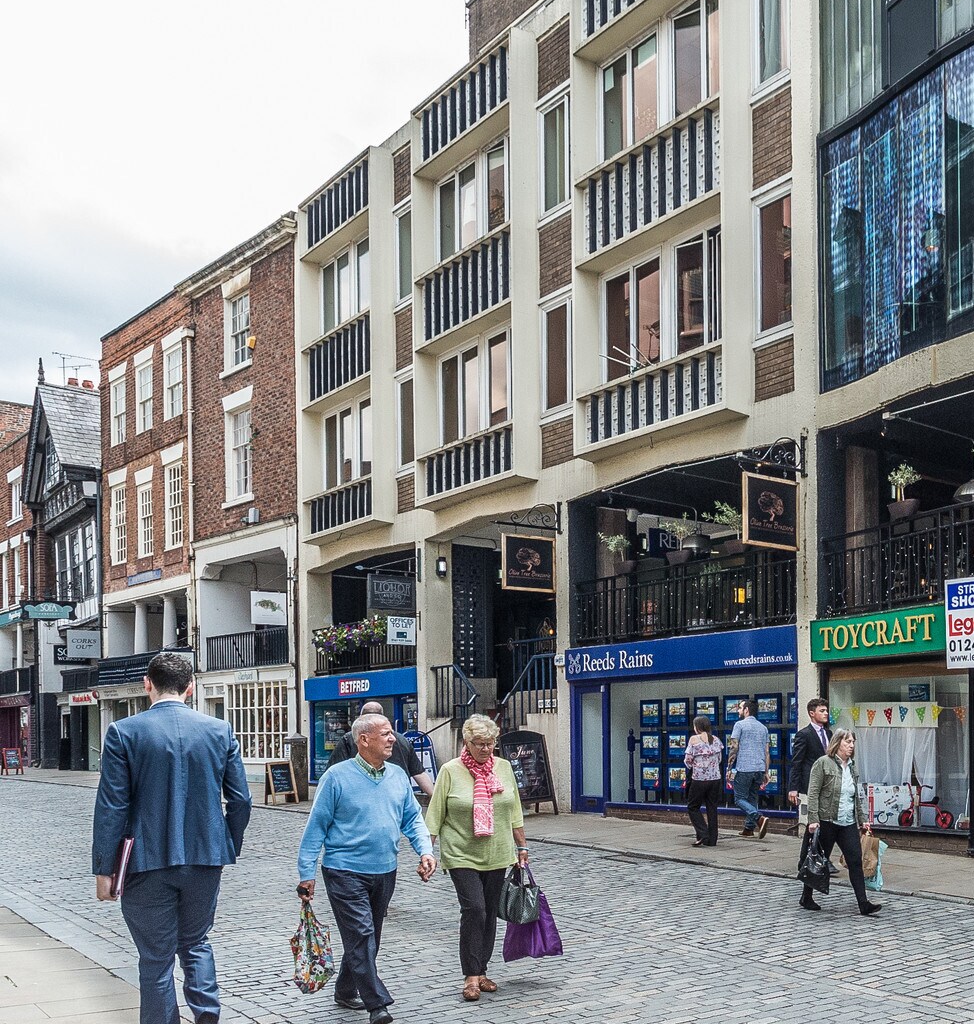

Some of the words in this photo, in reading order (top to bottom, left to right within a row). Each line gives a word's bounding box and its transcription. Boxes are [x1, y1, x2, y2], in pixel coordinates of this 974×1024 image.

[389, 617, 414, 625] OFFICES
[819, 613, 935, 652] TOYCRAFT
[582, 651, 616, 672] Reeds
[619, 650, 654, 670] Rains
[723, 653, 794, 666] www.reedsrains.co.uk
[340, 679, 370, 694] BETFRED
[510, 745, 535, 759] June
